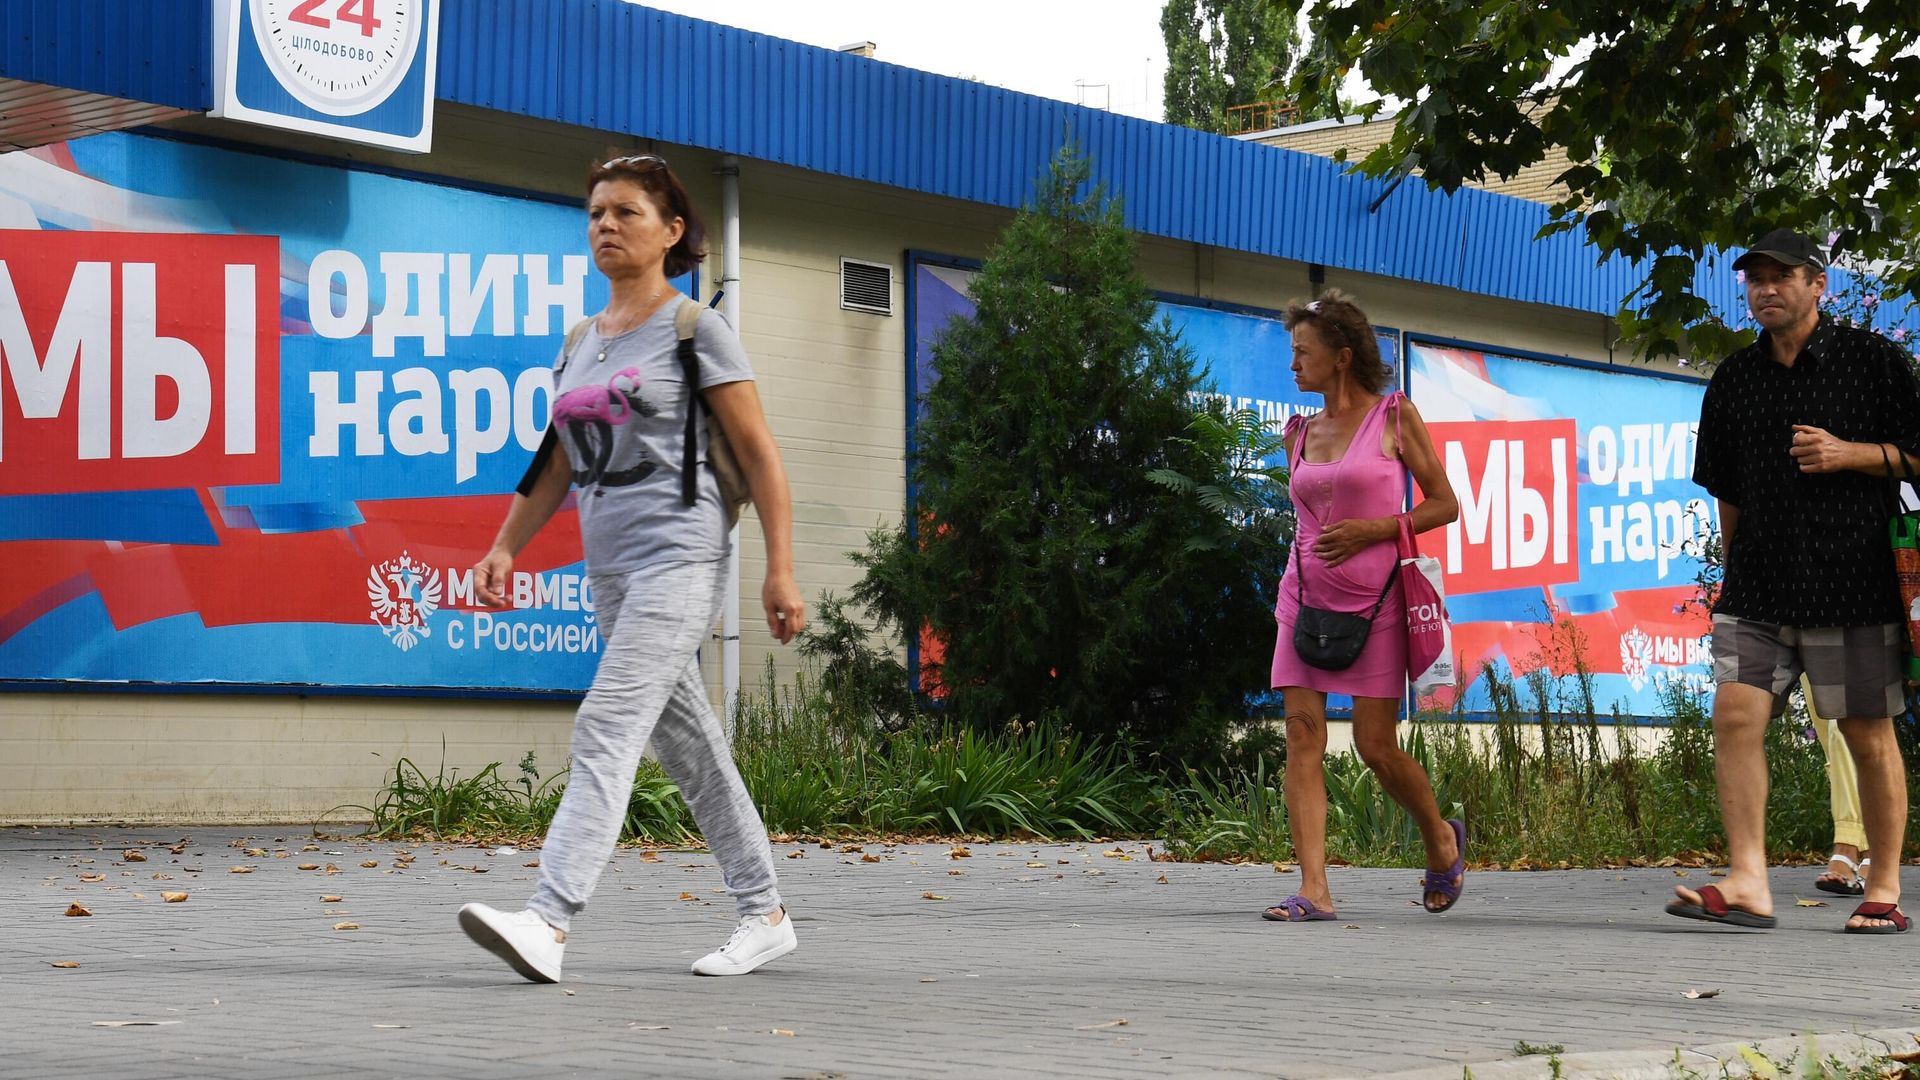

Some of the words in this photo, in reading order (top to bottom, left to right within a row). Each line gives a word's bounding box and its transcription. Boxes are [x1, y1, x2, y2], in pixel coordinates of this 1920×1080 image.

[292, 34, 374, 62] ЦІЛОДОБОВО
[308, 249, 589, 358] один
[0, 259, 256, 462] МЫ
[308, 367, 554, 485] наро
[1445, 438, 1568, 575] МЫ
[1589, 497, 1722, 581] наро
[447, 568, 506, 608] М
[512, 571, 595, 613] ВМЕС
[447, 619, 465, 649] с
[474, 611, 598, 653] Россией
[1655, 635, 1684, 664] МЫ
